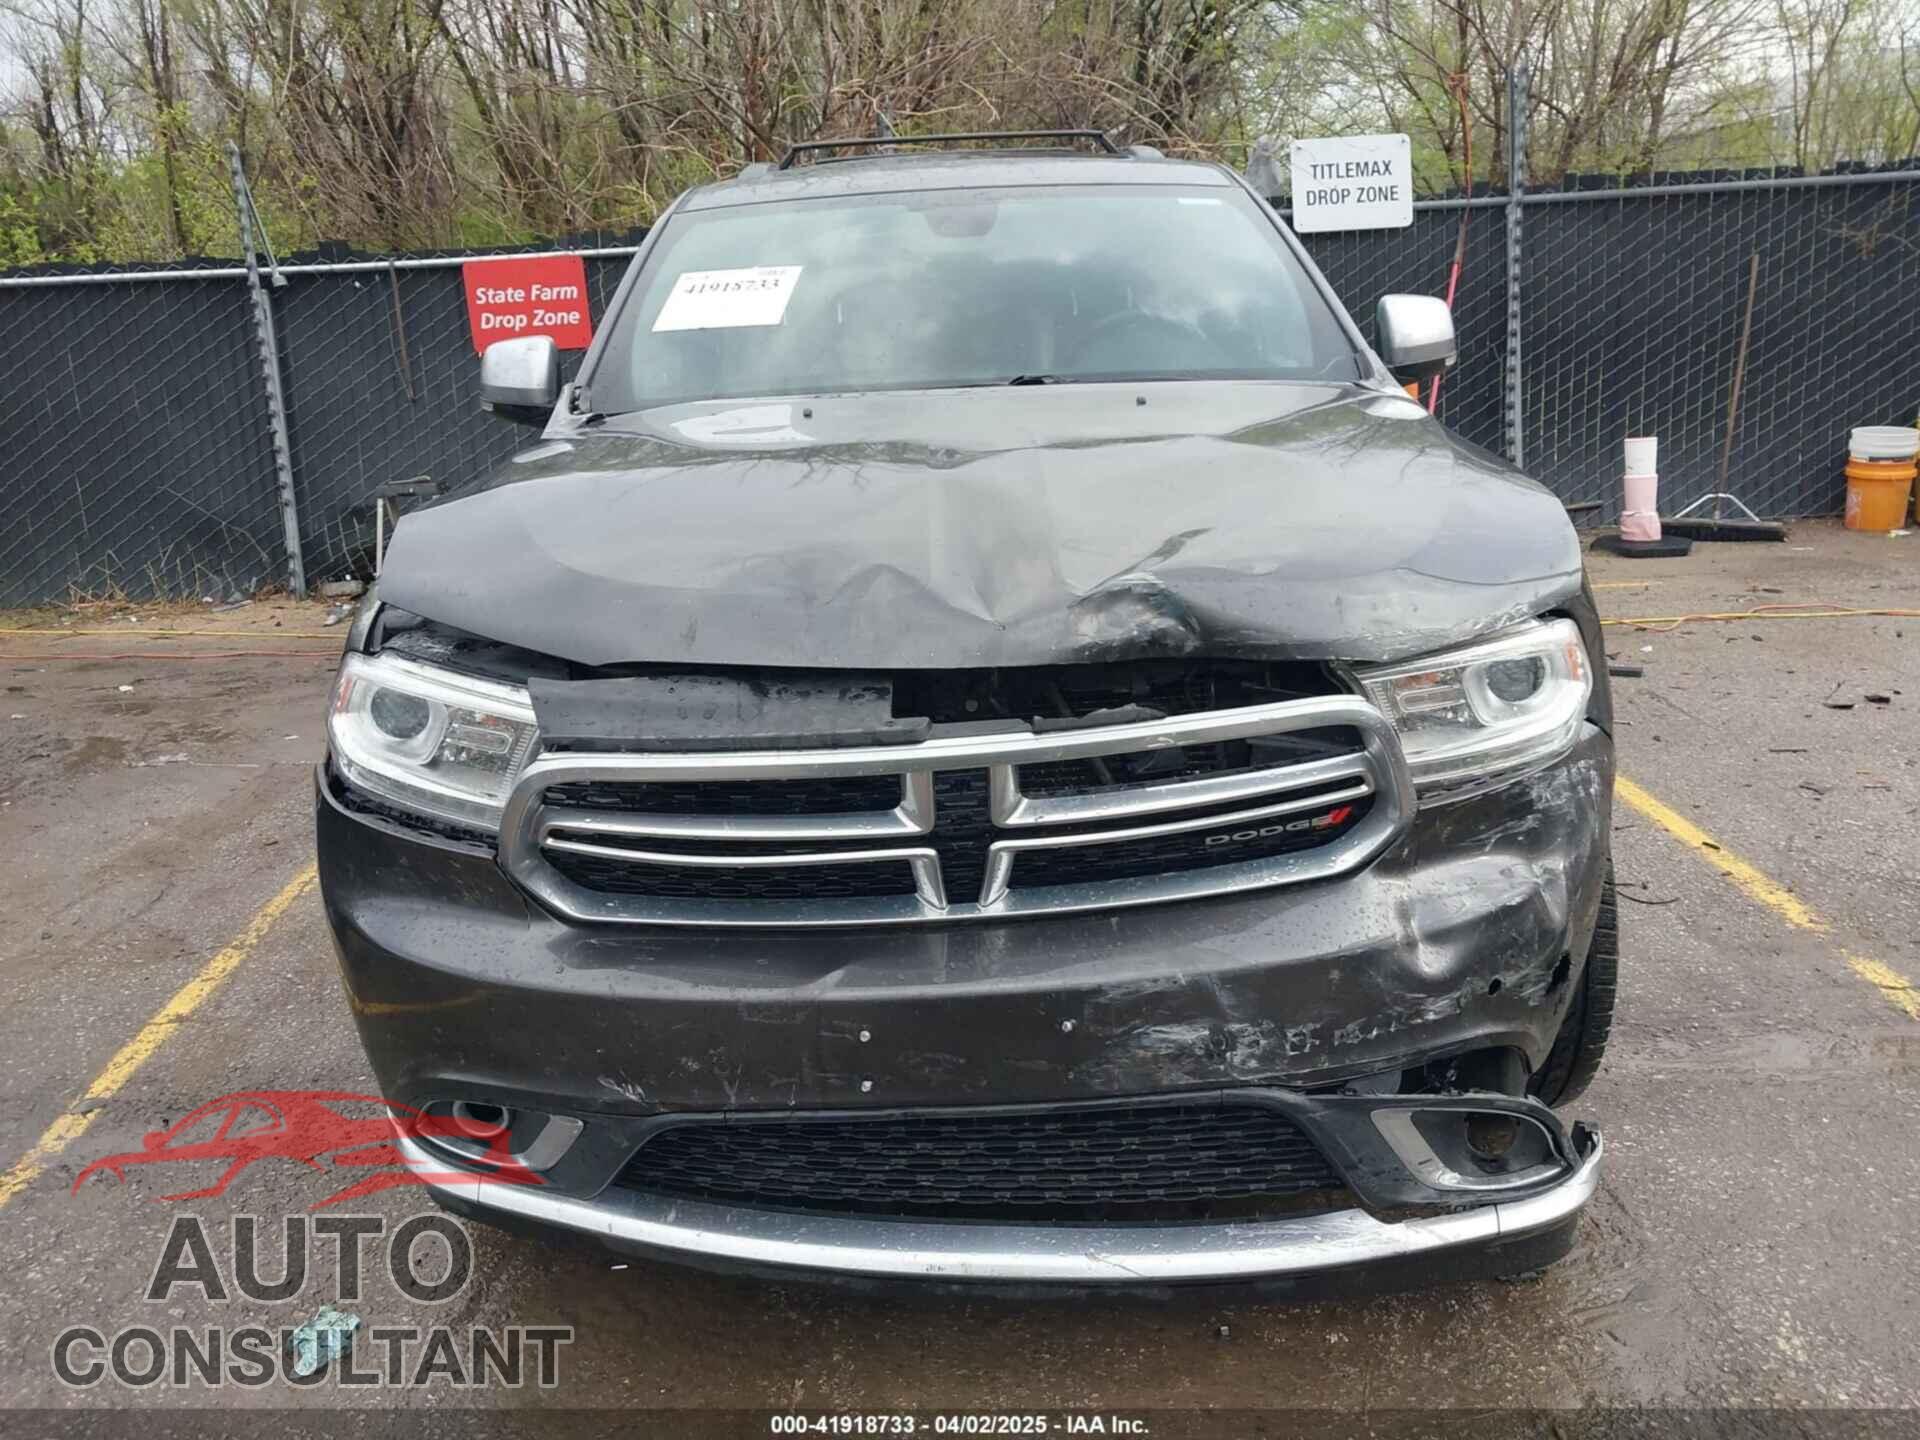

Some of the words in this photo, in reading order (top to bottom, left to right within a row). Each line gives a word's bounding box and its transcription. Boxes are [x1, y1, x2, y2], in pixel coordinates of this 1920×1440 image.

[1310, 160, 1392, 180] TITLEMAX
[1306, 188, 1351, 206] DROP
[1356, 185, 1399, 203] ZONE
[475, 286, 526, 305] State
[530, 284, 578, 301] Farm
[480, 311, 527, 330] Drop
[532, 309, 581, 326] Zone
[1204, 815, 1333, 846] DODGE
